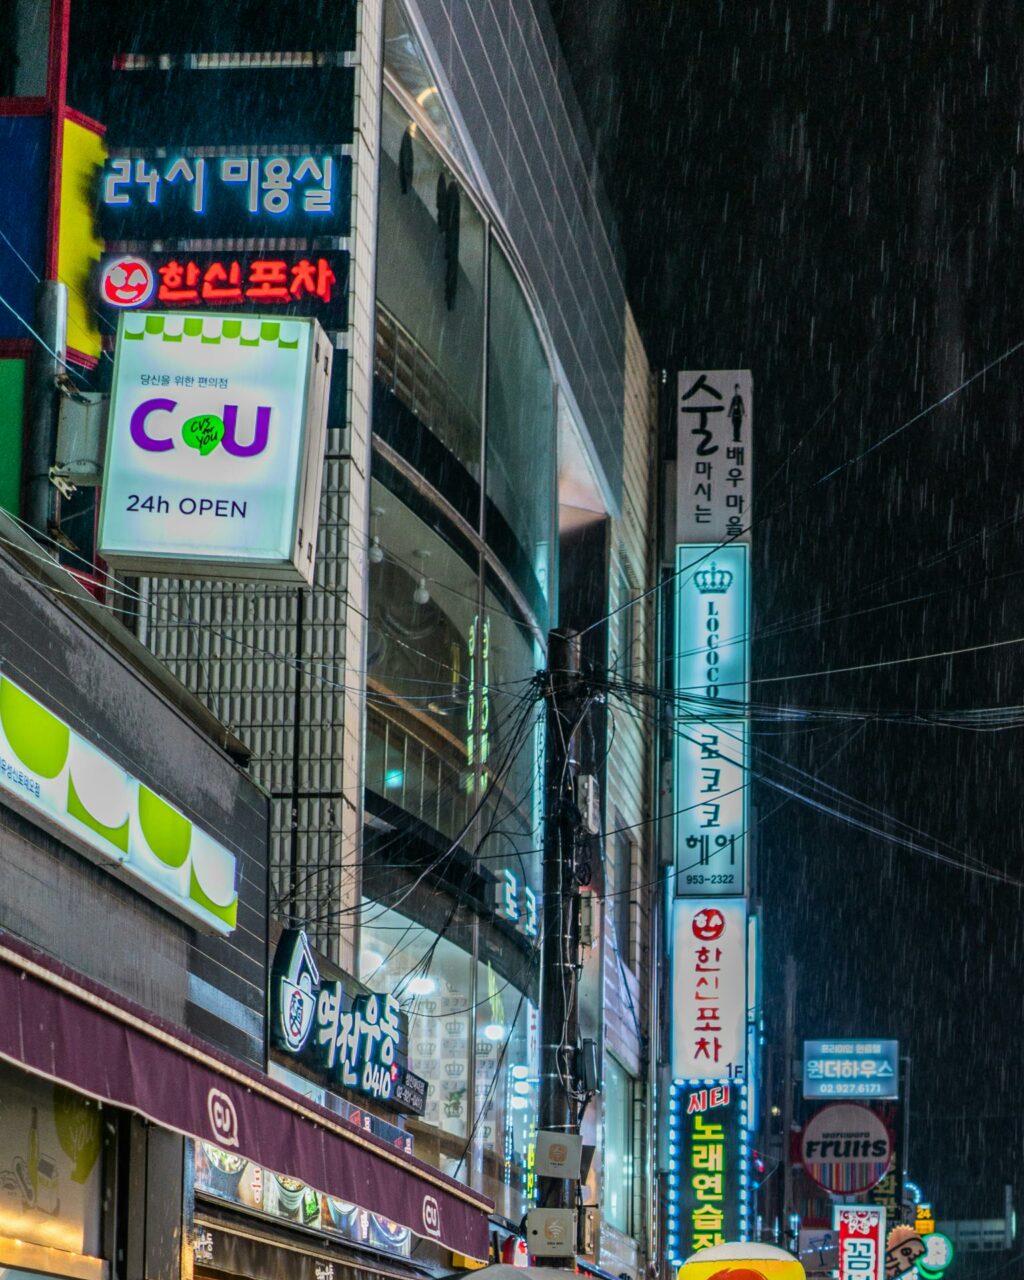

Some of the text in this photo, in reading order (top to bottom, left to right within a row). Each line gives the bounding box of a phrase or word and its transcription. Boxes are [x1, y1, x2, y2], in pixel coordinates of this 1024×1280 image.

[105, 158, 333, 214] 24시 미용실
[157, 258, 337, 304] 한신포차
[140, 374, 228, 389] 당신을 위한 편의점
[130, 398, 272, 458] CU
[681, 374, 725, 457] 술
[126, 494, 247, 518] 24h OPEN
[705, 600, 721, 699] LOCOCO
[700, 733, 721, 829] 로코코
[685, 833, 737, 866] 헤어
[686, 874, 735, 885] 953-2322
[694, 946, 723, 1063] 한신포차
[318, 980, 400, 1085] 역전우동
[363, 1061, 391, 1098] 0410
[725, 1063, 743, 1078] 1F
[807, 1059, 894, 1079] 원더하우스
[213, 1101, 231, 1133] CU
[687, 1085, 729, 1114] 시티
[425, 1205, 437, 1224] CU
